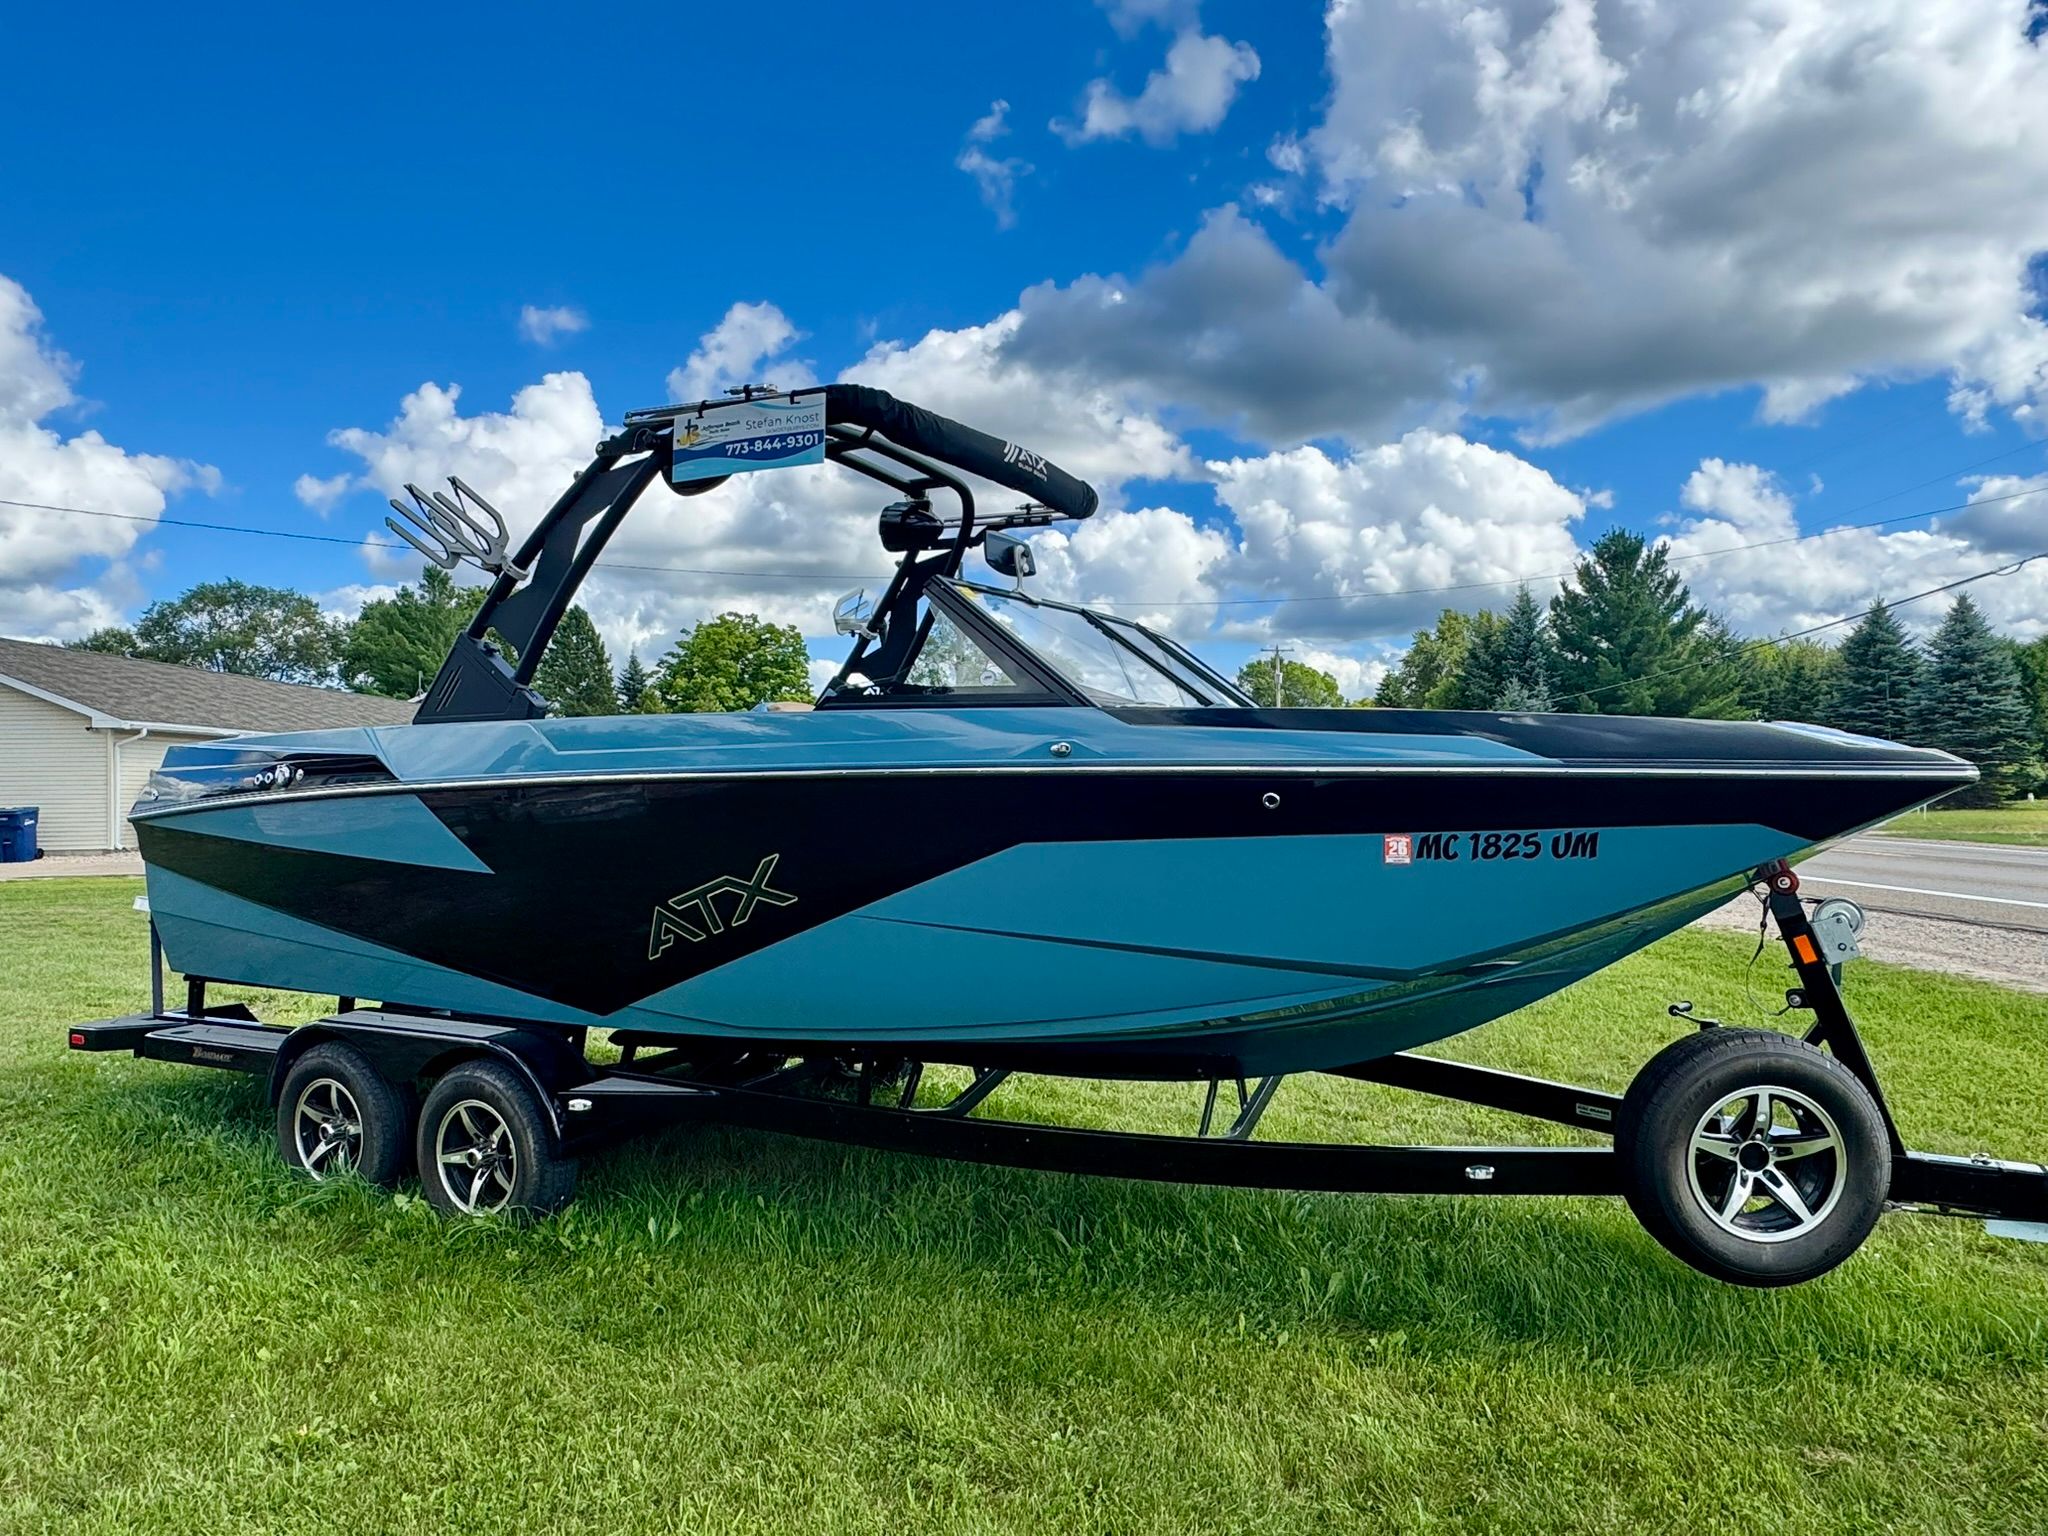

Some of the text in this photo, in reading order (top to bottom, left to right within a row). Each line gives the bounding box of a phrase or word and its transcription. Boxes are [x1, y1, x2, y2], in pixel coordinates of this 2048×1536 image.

[745, 416, 782, 431] Stefan
[786, 412, 819, 425] Knost
[725, 433, 820, 457] 773-844-9301
[1388, 840, 1408, 855] 26
[1415, 830, 1599, 861] MC 1825 UM
[648, 853, 798, 960] ATX
